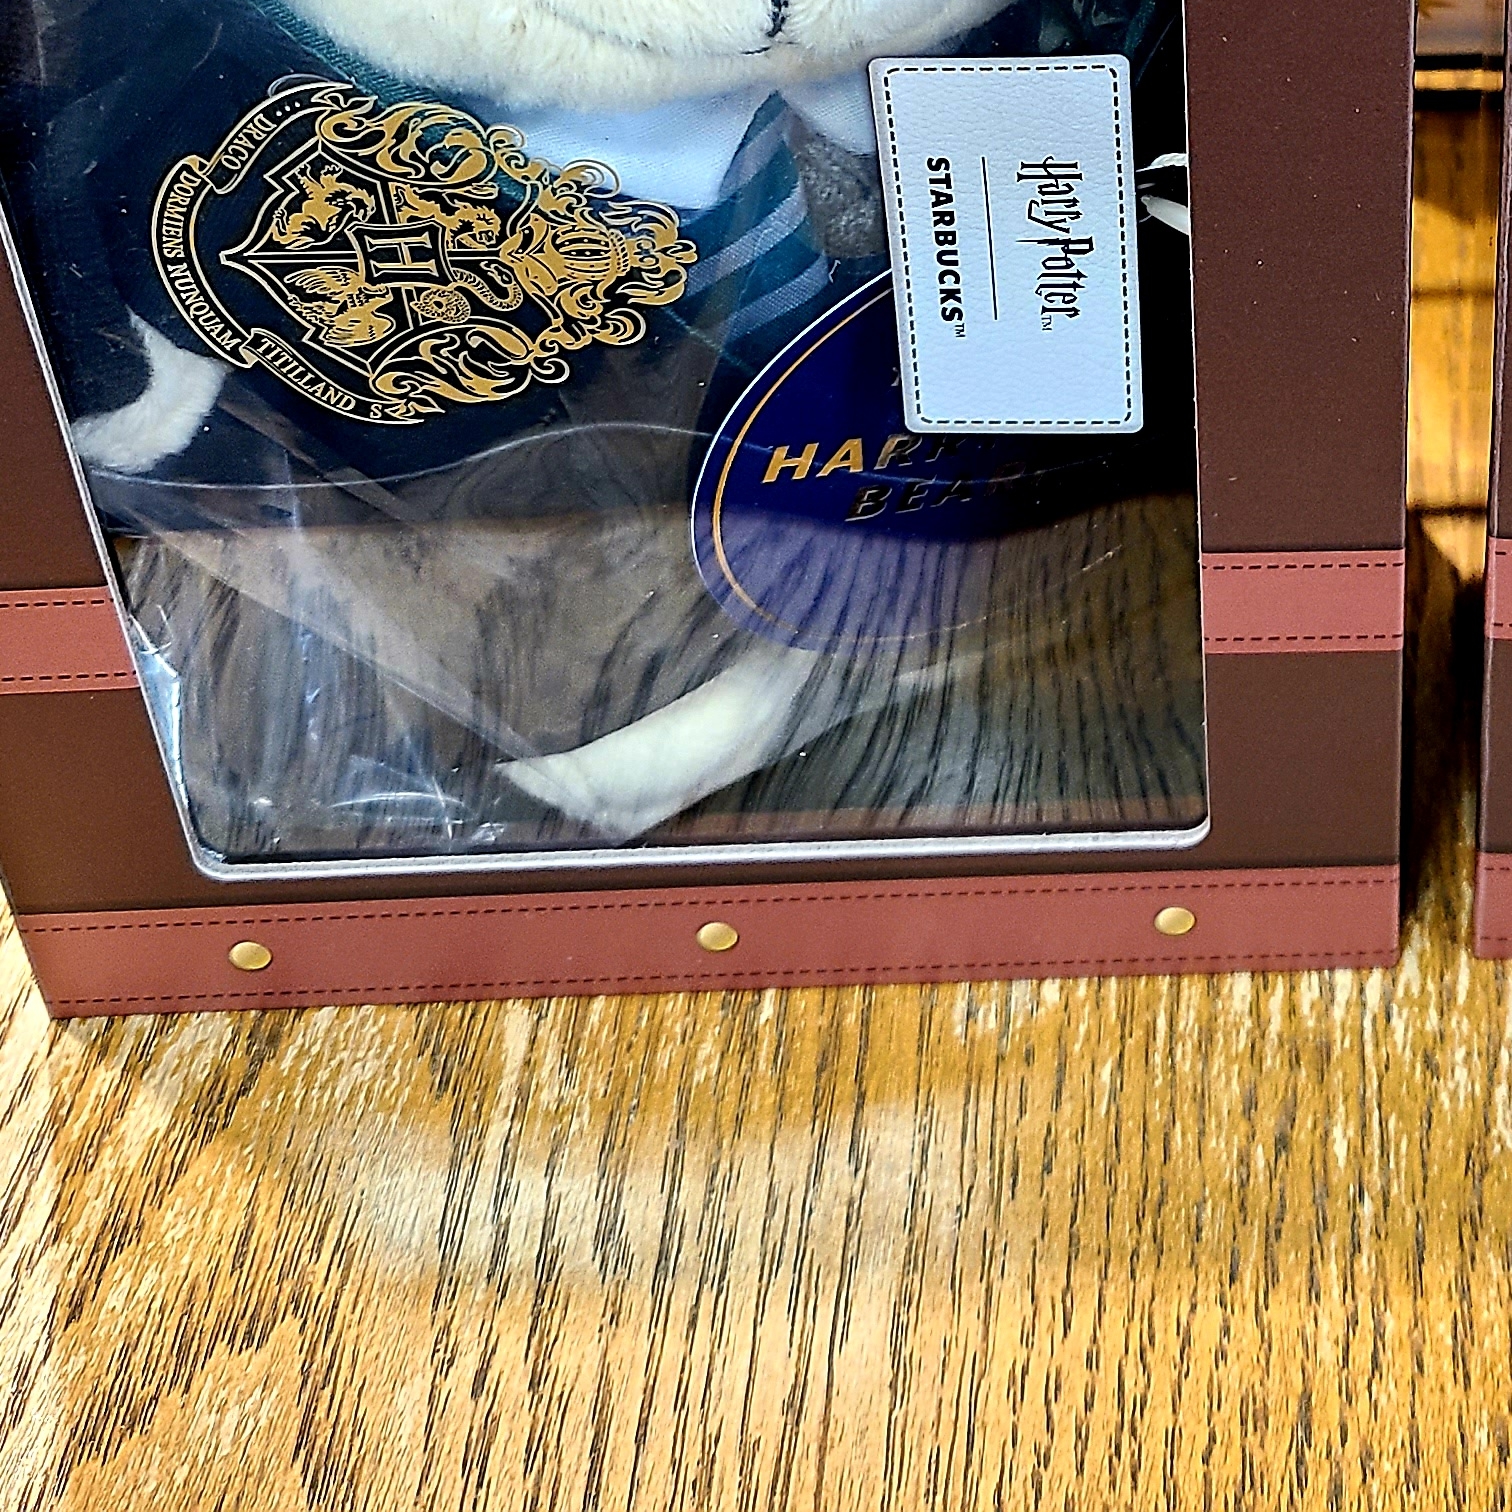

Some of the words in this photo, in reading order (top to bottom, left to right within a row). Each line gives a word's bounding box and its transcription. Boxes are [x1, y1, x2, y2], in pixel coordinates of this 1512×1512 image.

[221, 113, 277, 170] DRACO
[161, 170, 201, 259] DORMIENS
[1016, 155, 1083, 234] Harry
[926, 156, 964, 324] STARBUCKS
[1015, 234, 1094, 322] Potter
[167, 262, 241, 351] NUNQUAM
[256, 337, 383, 419] TITILLANDS
